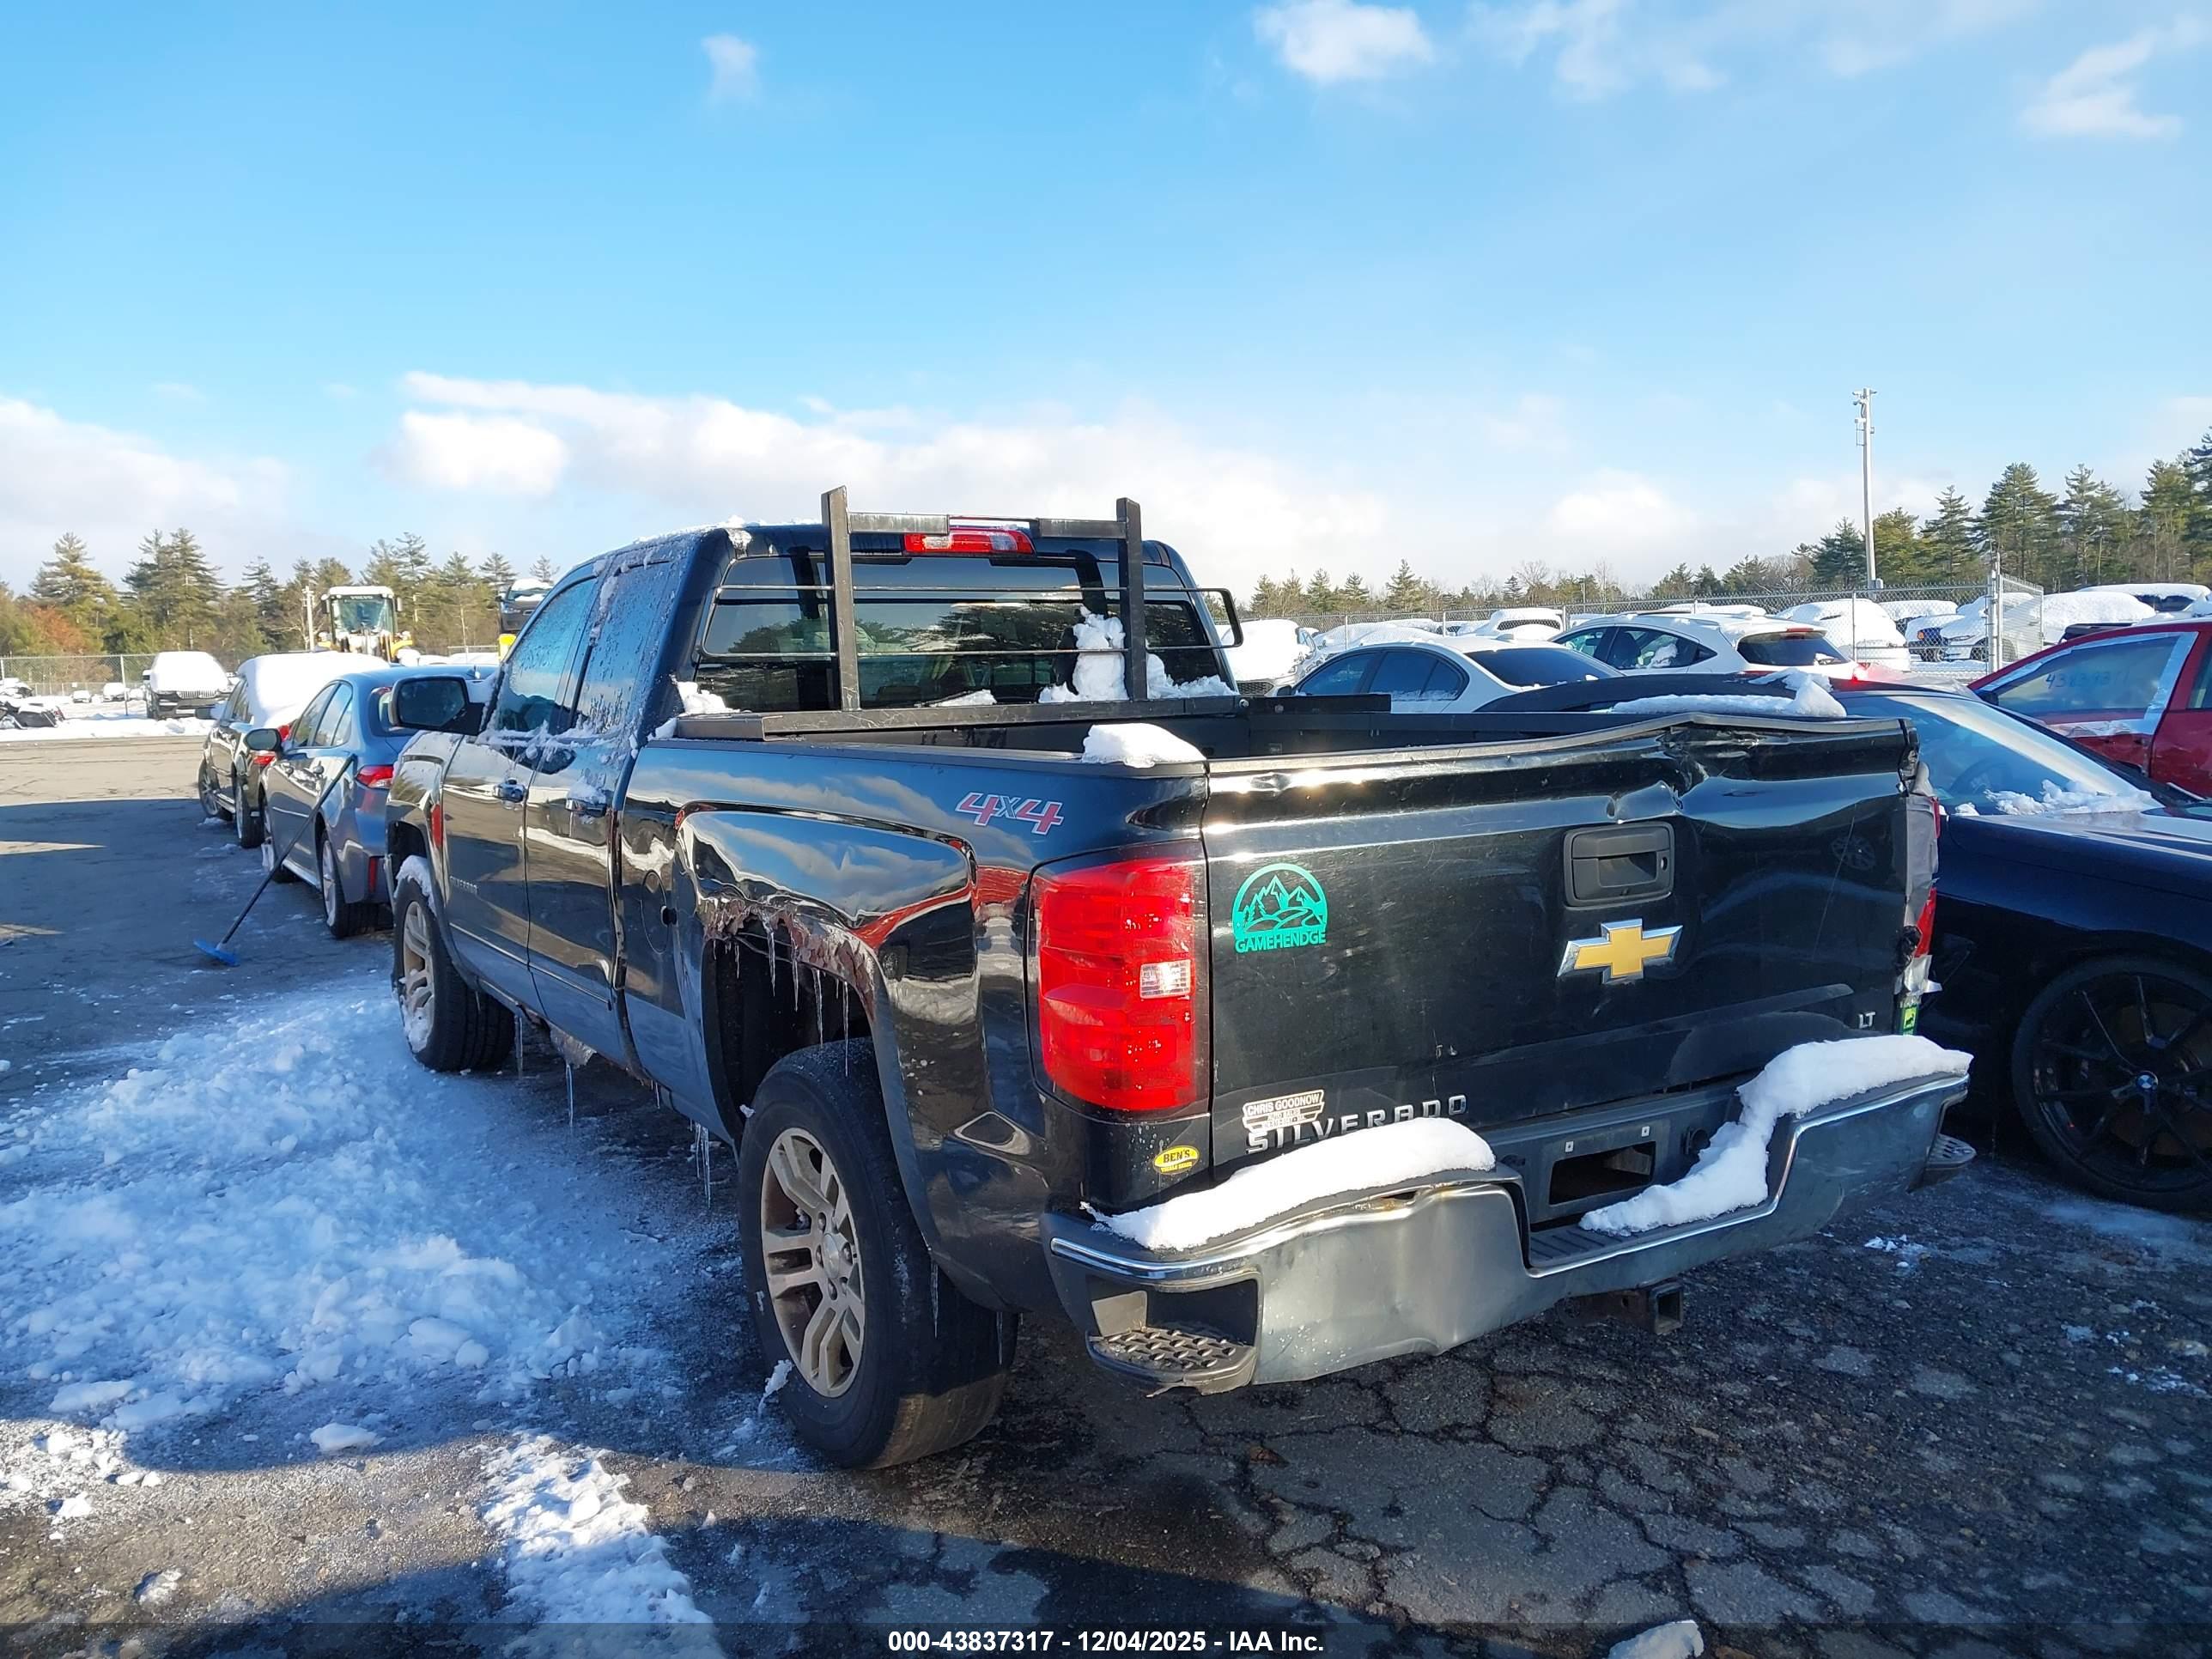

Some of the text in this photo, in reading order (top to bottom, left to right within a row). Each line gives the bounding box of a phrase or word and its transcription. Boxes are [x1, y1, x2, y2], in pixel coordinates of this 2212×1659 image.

[1235, 930, 1327, 953] GAMEHENDGE
[1858, 1012, 1876, 1029] LT
[1247, 1093, 1320, 1116] CHRIS GOODNOW
[1246, 1095, 1468, 1155] SILVERADO
[1163, 1149, 1190, 1164] BEN'S
